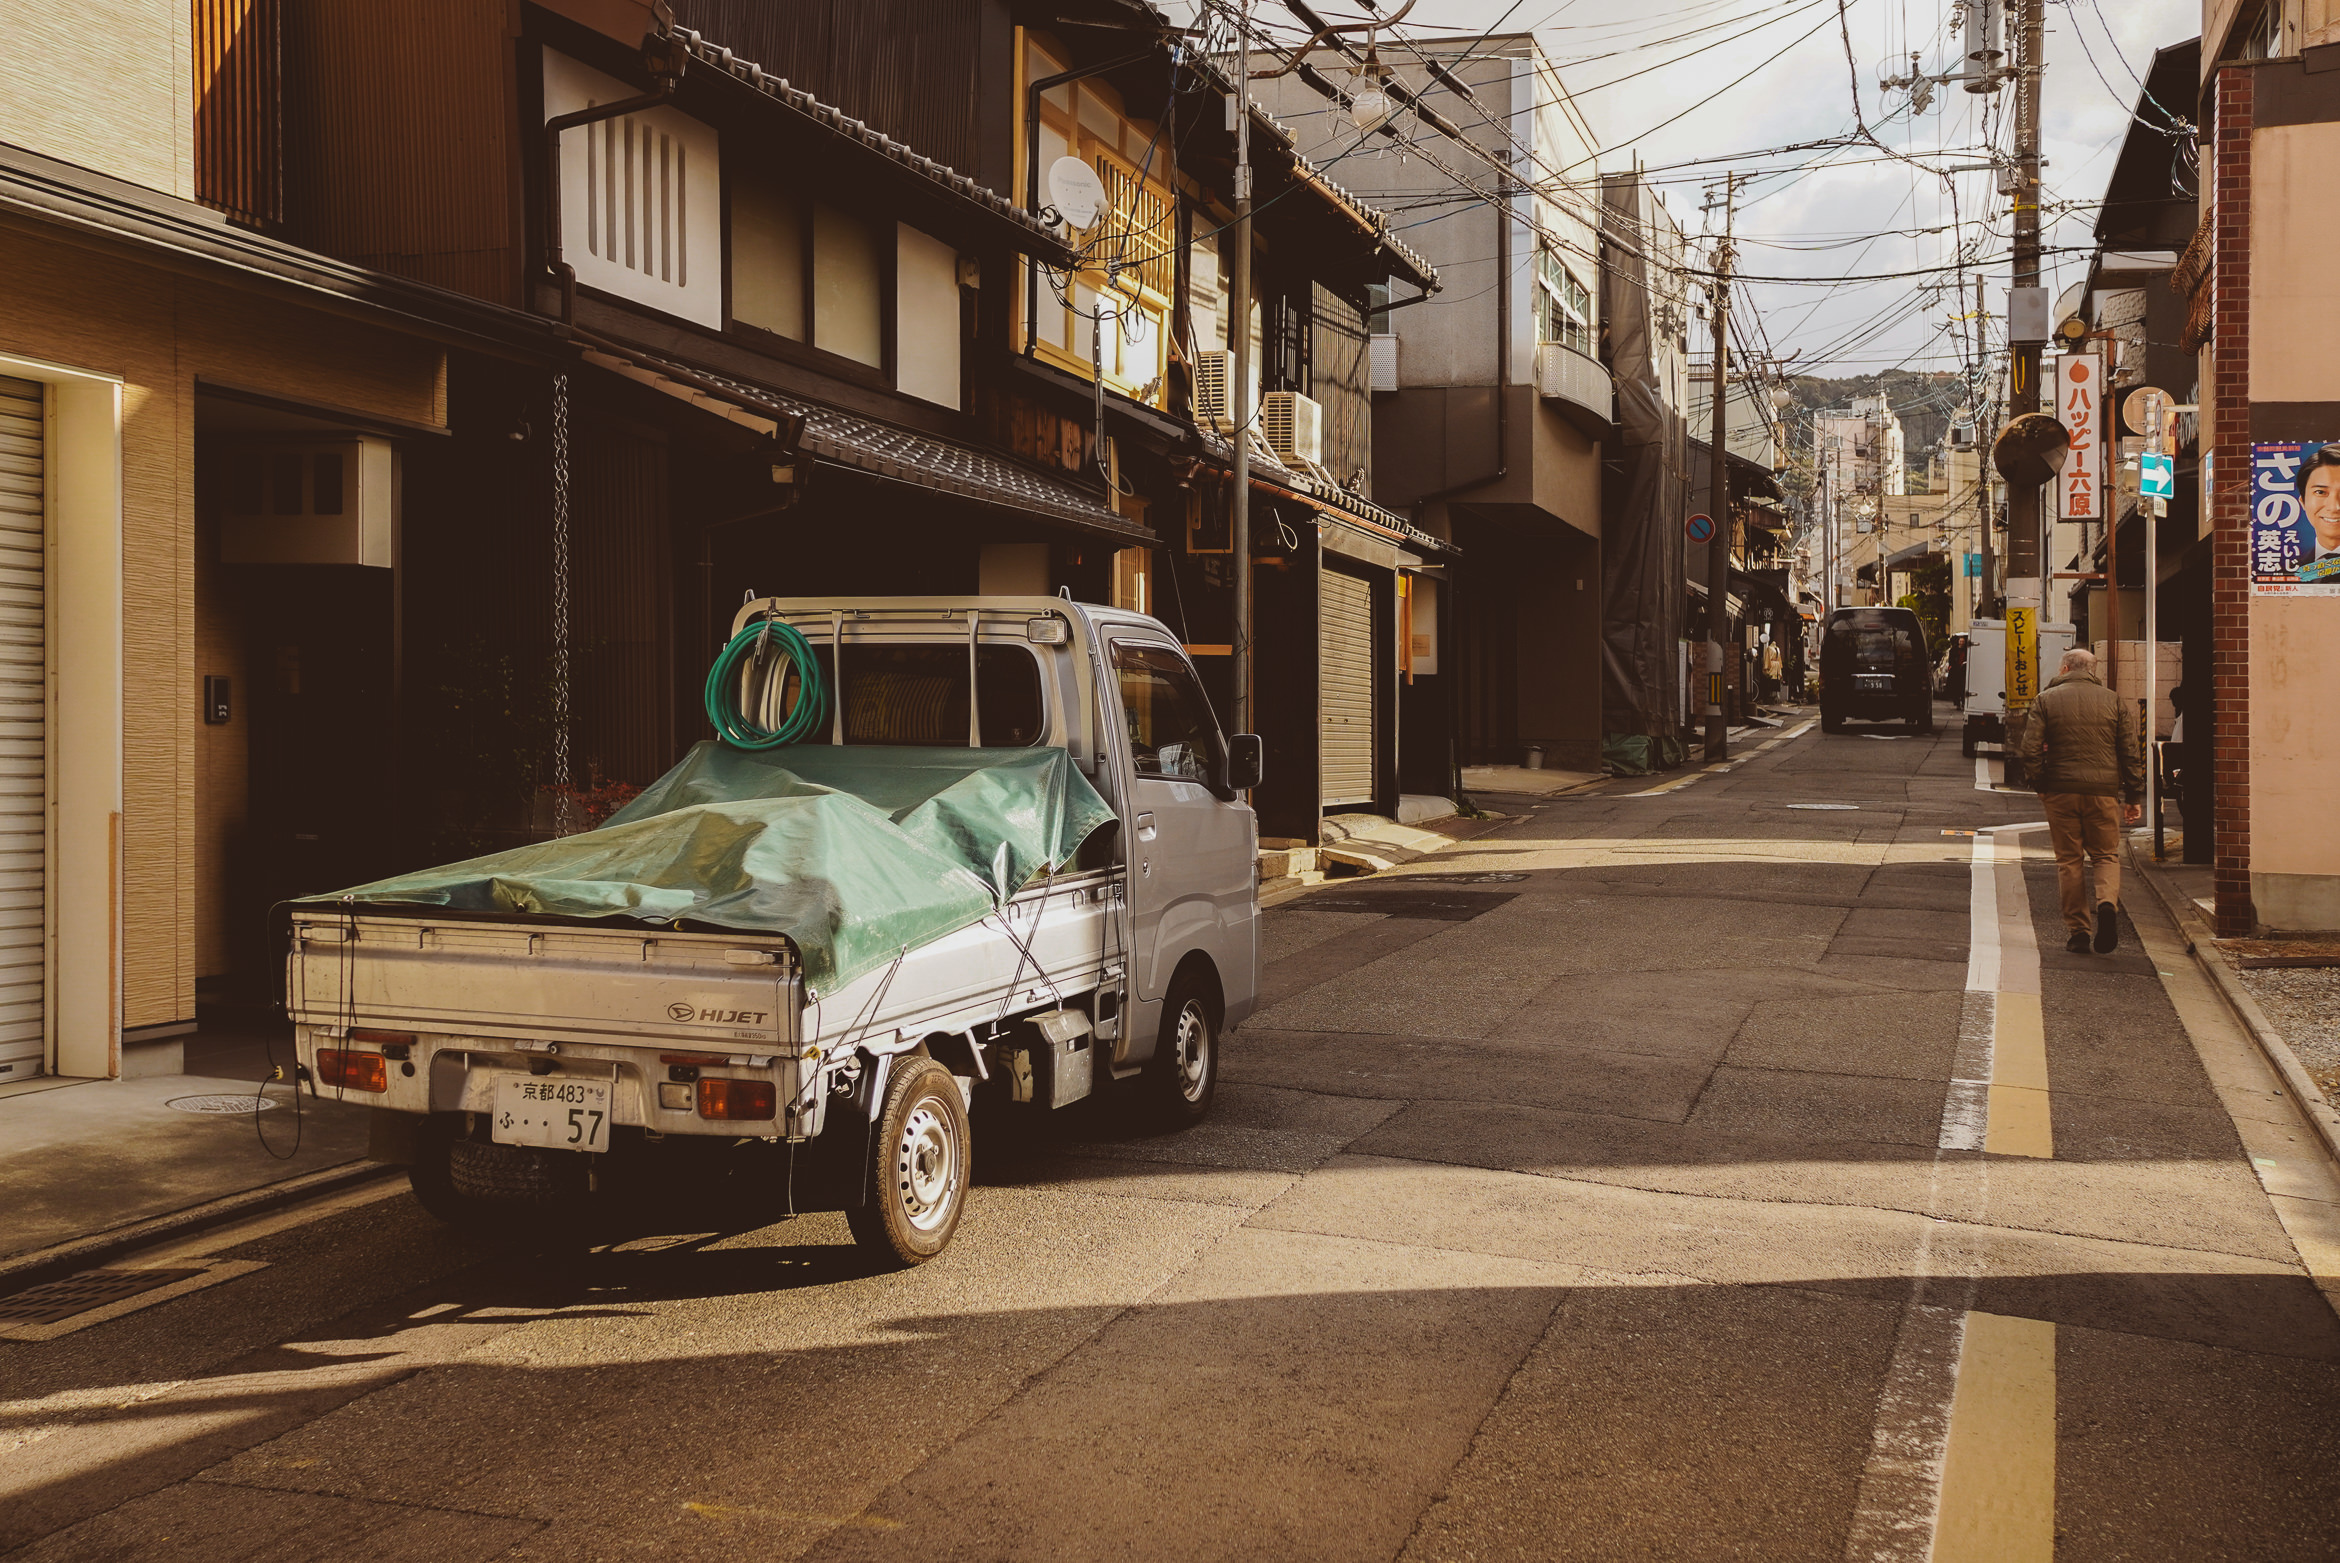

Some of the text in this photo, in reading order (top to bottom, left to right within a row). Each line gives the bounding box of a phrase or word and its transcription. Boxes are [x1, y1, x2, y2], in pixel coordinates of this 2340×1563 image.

[2067, 388, 2092, 516] ハッピー六原
[2256, 452, 2301, 529] さの
[2257, 529, 2282, 573] 英志
[2283, 530, 2301, 573] えいじ
[2013, 611, 2029, 697] スピードおとせ
[699, 1009, 768, 1024] HIJET
[499, 1111, 514, 1129] ふ
[567, 1108, 604, 1145] 57
